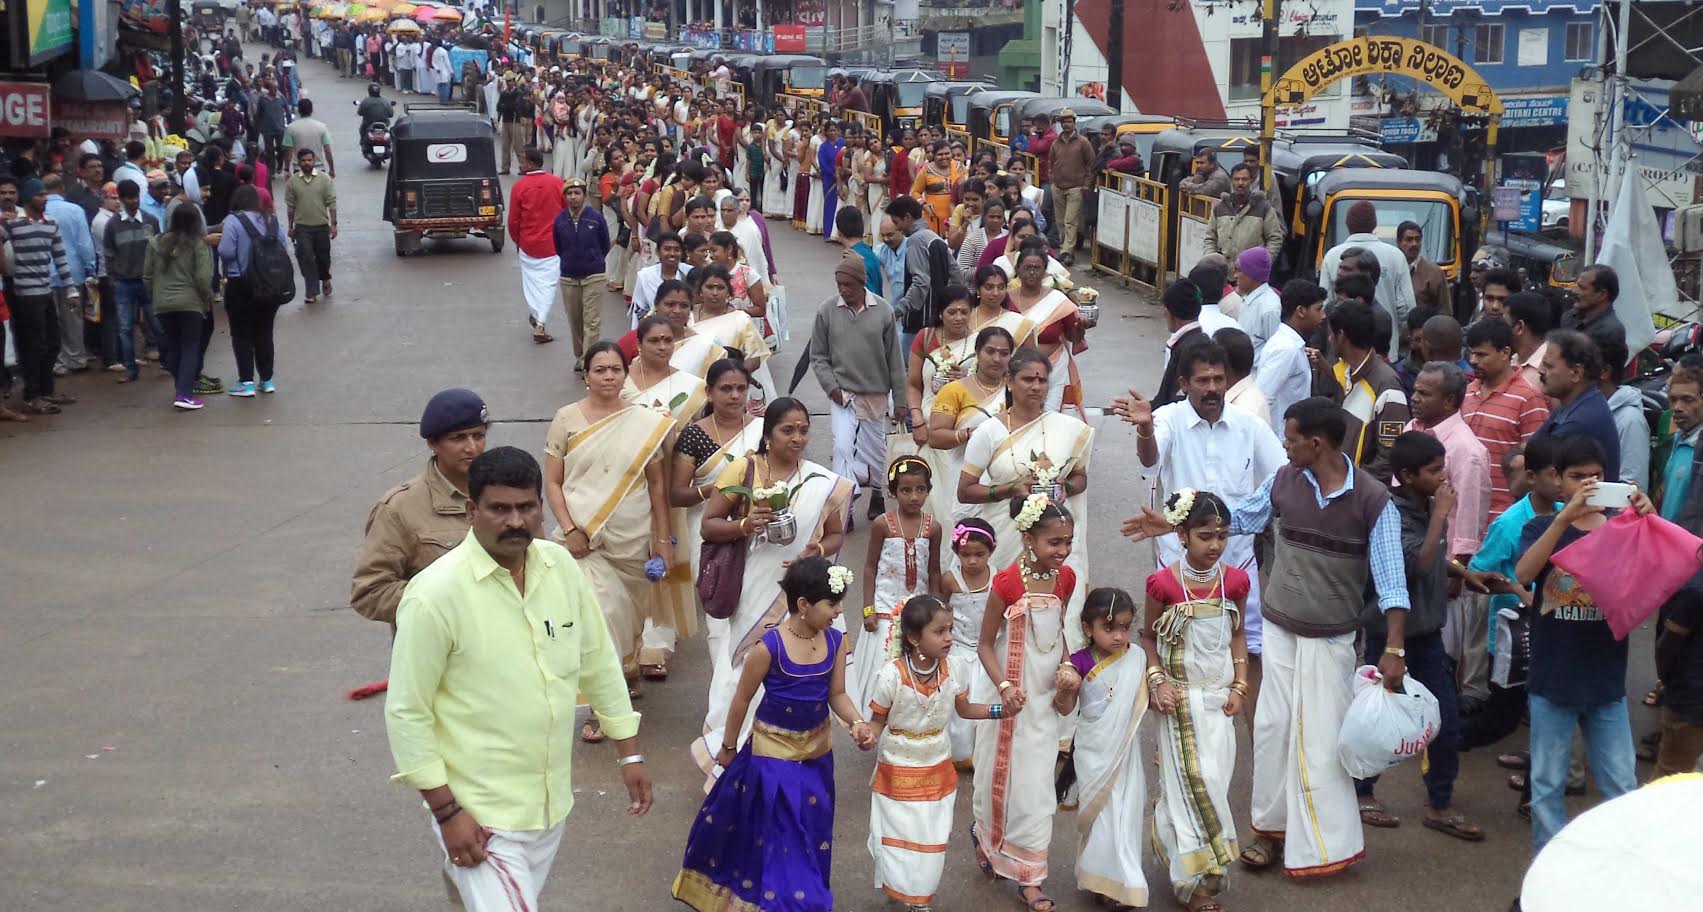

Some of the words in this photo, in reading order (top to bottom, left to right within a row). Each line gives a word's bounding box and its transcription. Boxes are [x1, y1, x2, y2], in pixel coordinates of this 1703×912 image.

[1303, 44, 1363, 87] ಆಟೋ
[1368, 40, 1403, 70] ರಿಕ್ಷಾ
[1407, 44, 1466, 89] ನಿಲ್ದಾಣ
[0, 93, 44, 126] GE
[1532, 107, 1562, 117] CENTRE
[1400, 127, 1418, 135] TOOLS
[1383, 423, 1402, 435] F-1
[1554, 606, 1607, 621] ACADEM
